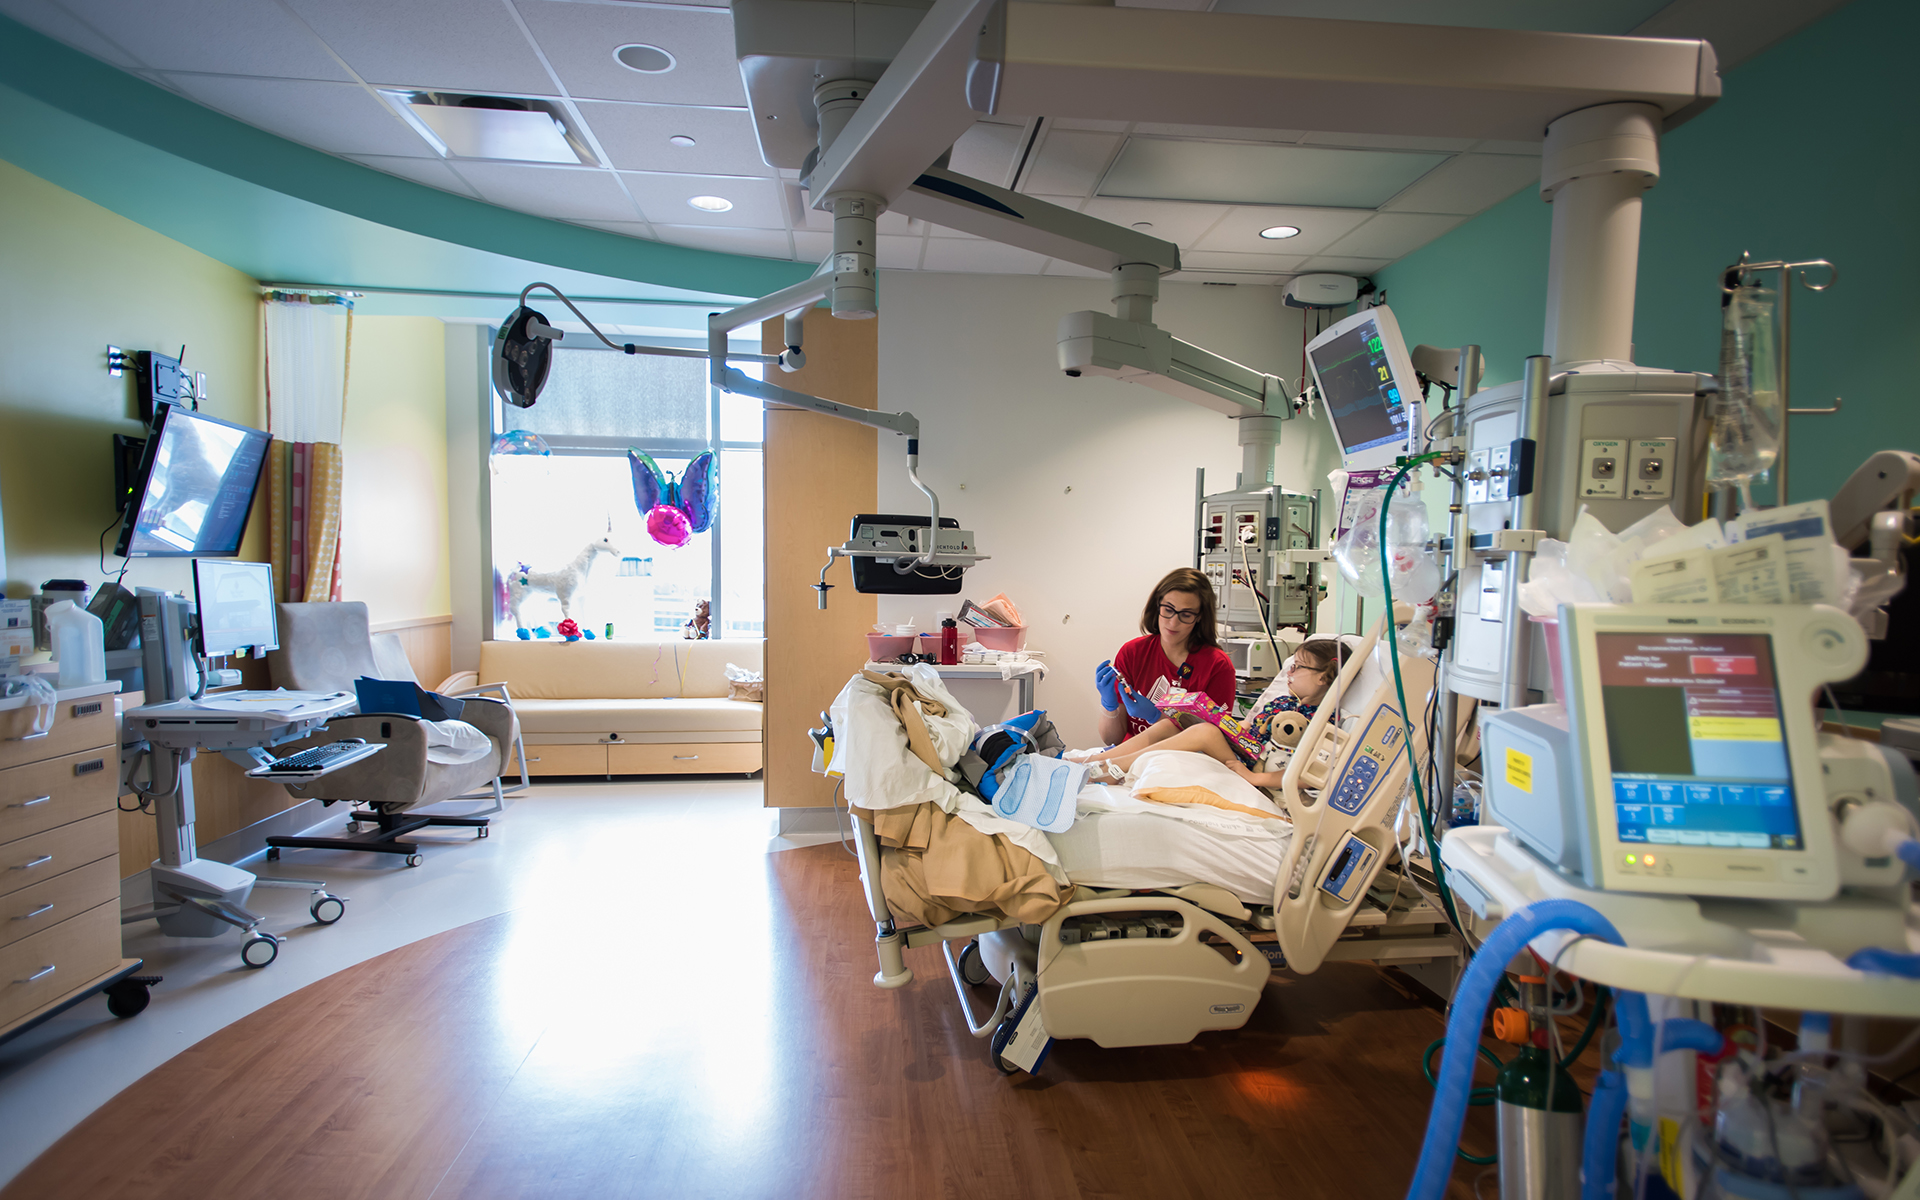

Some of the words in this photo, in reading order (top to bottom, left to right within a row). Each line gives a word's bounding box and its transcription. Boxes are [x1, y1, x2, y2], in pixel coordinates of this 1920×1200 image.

[1368, 337, 1384, 353] 122
[1378, 366, 1389, 381] 21
[1388, 388, 1400, 403] 99
